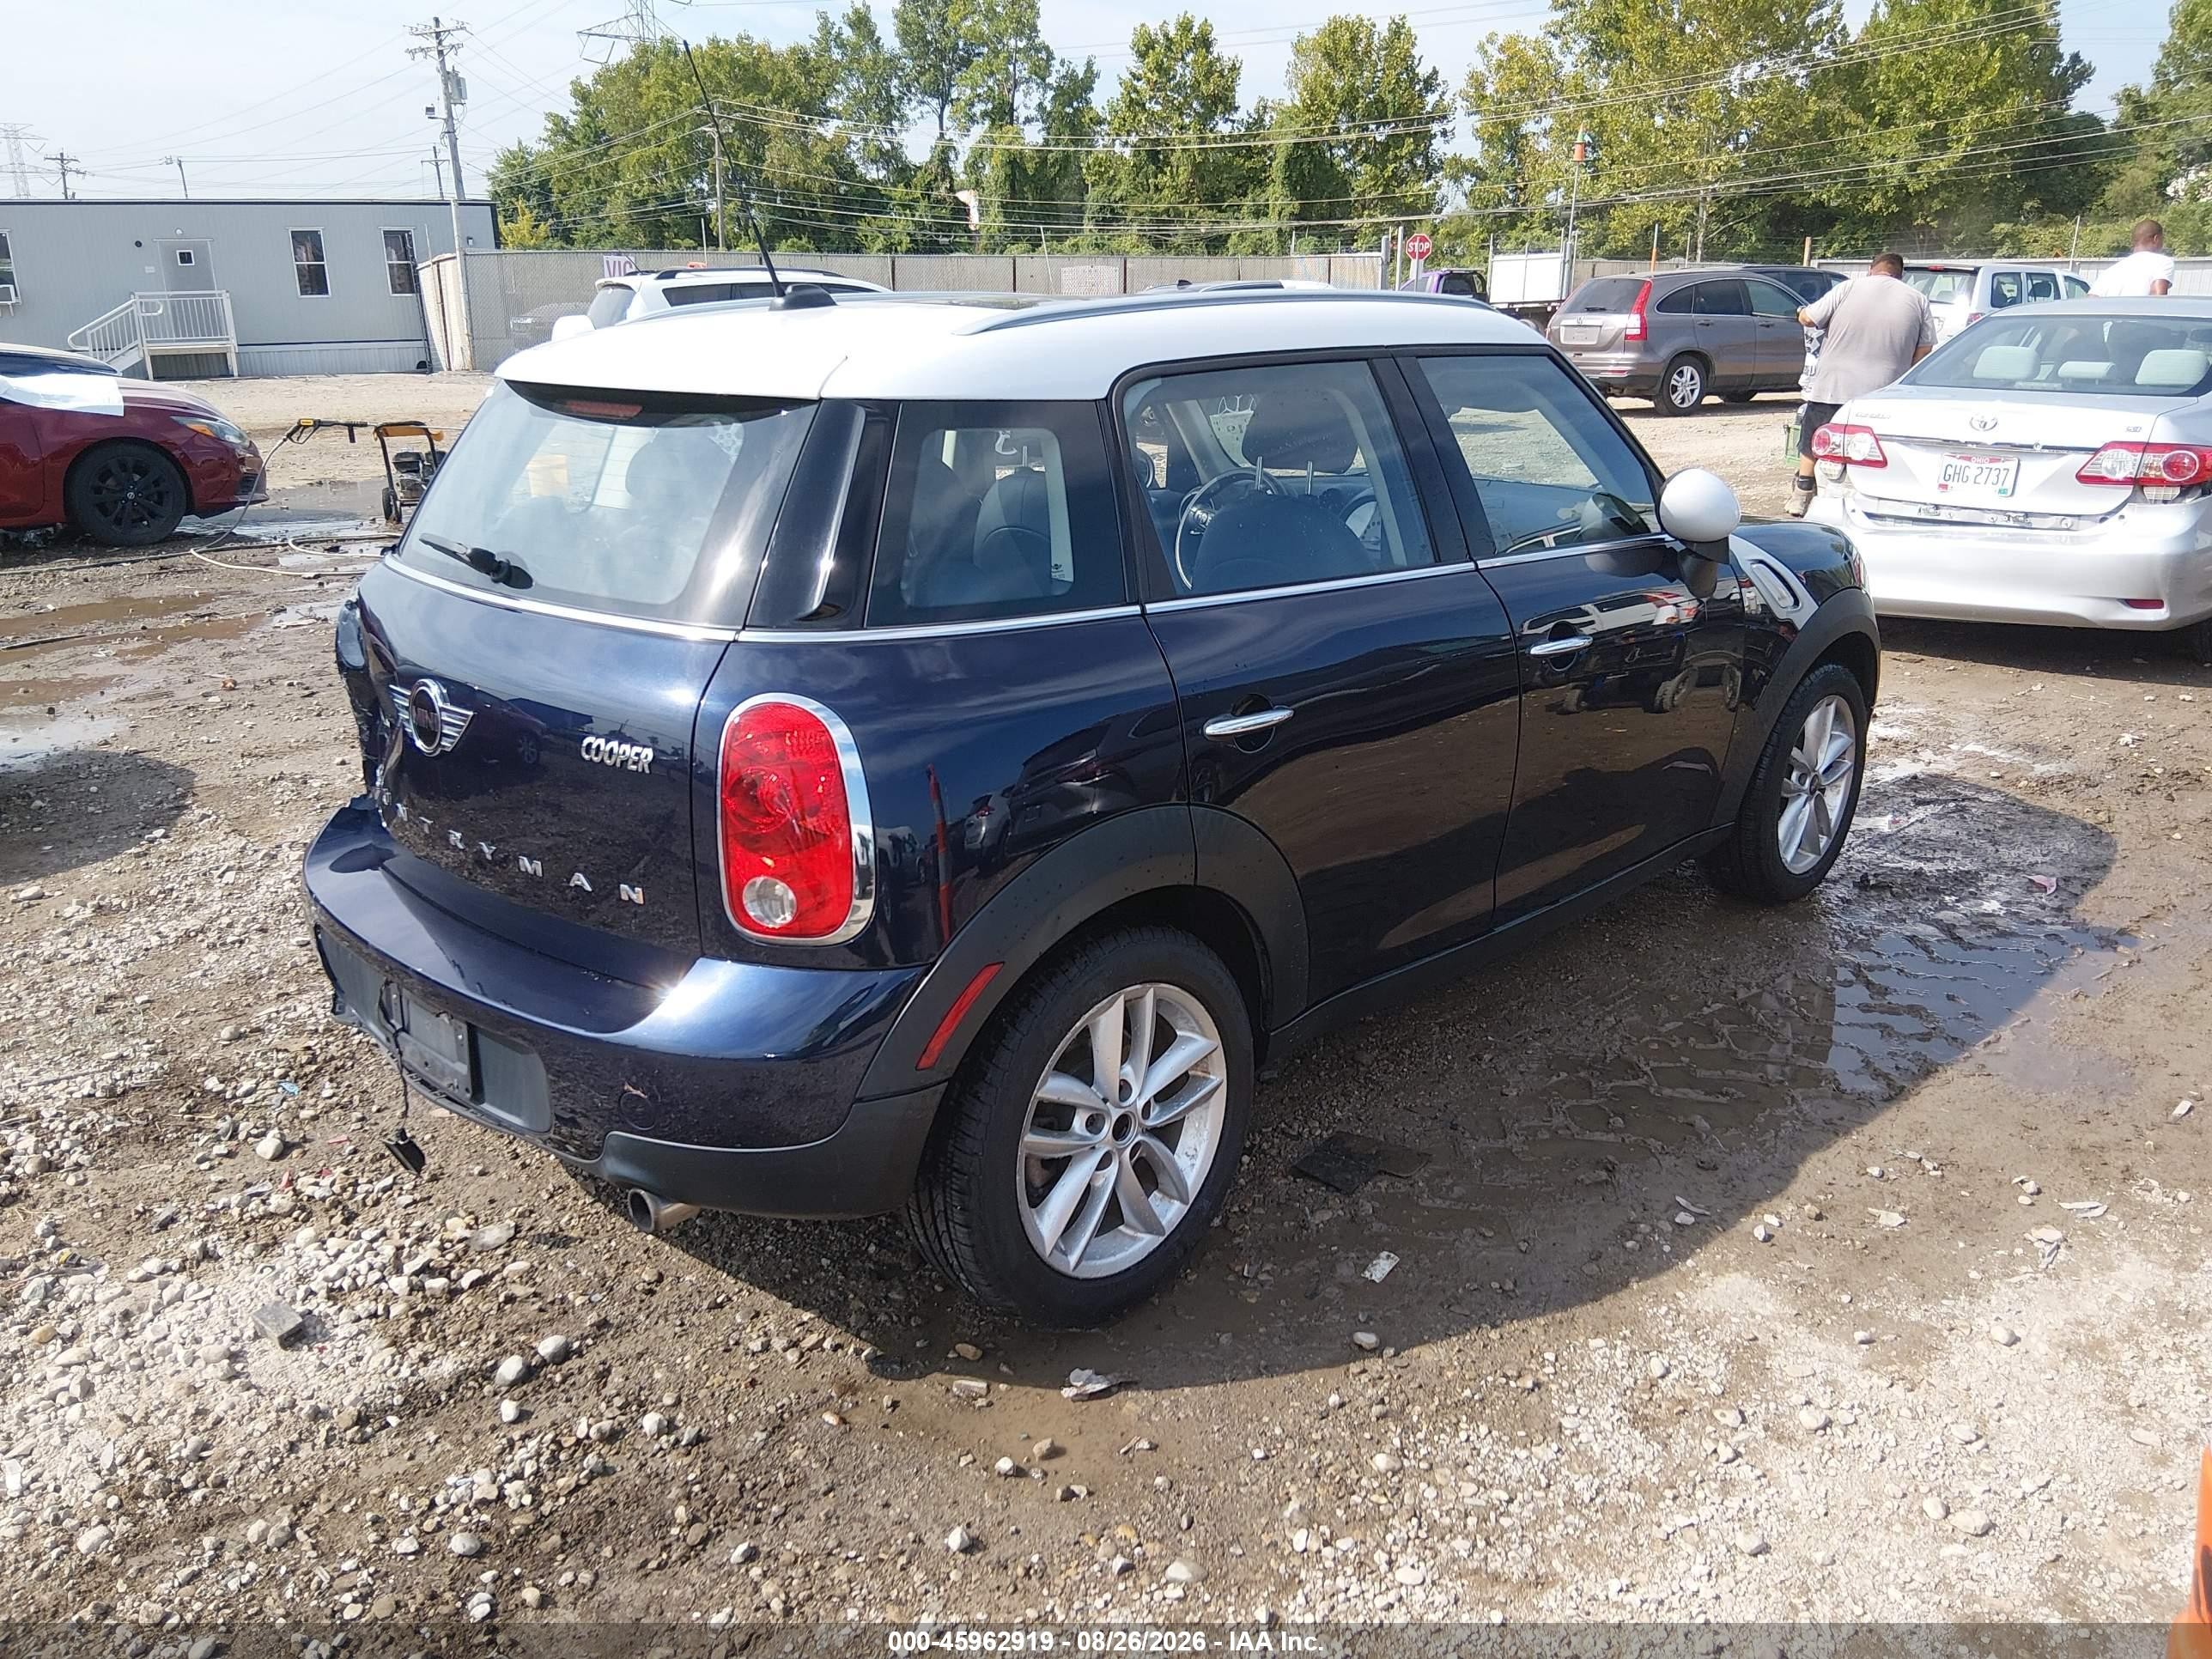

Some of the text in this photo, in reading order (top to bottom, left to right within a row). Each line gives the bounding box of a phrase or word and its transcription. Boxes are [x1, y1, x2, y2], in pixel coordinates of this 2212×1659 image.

[1408, 241, 1430, 253] STOP
[1971, 456, 1990, 465] OHIO
[1942, 464, 2010, 487] GHG 2737
[580, 736, 653, 774] COOPER
